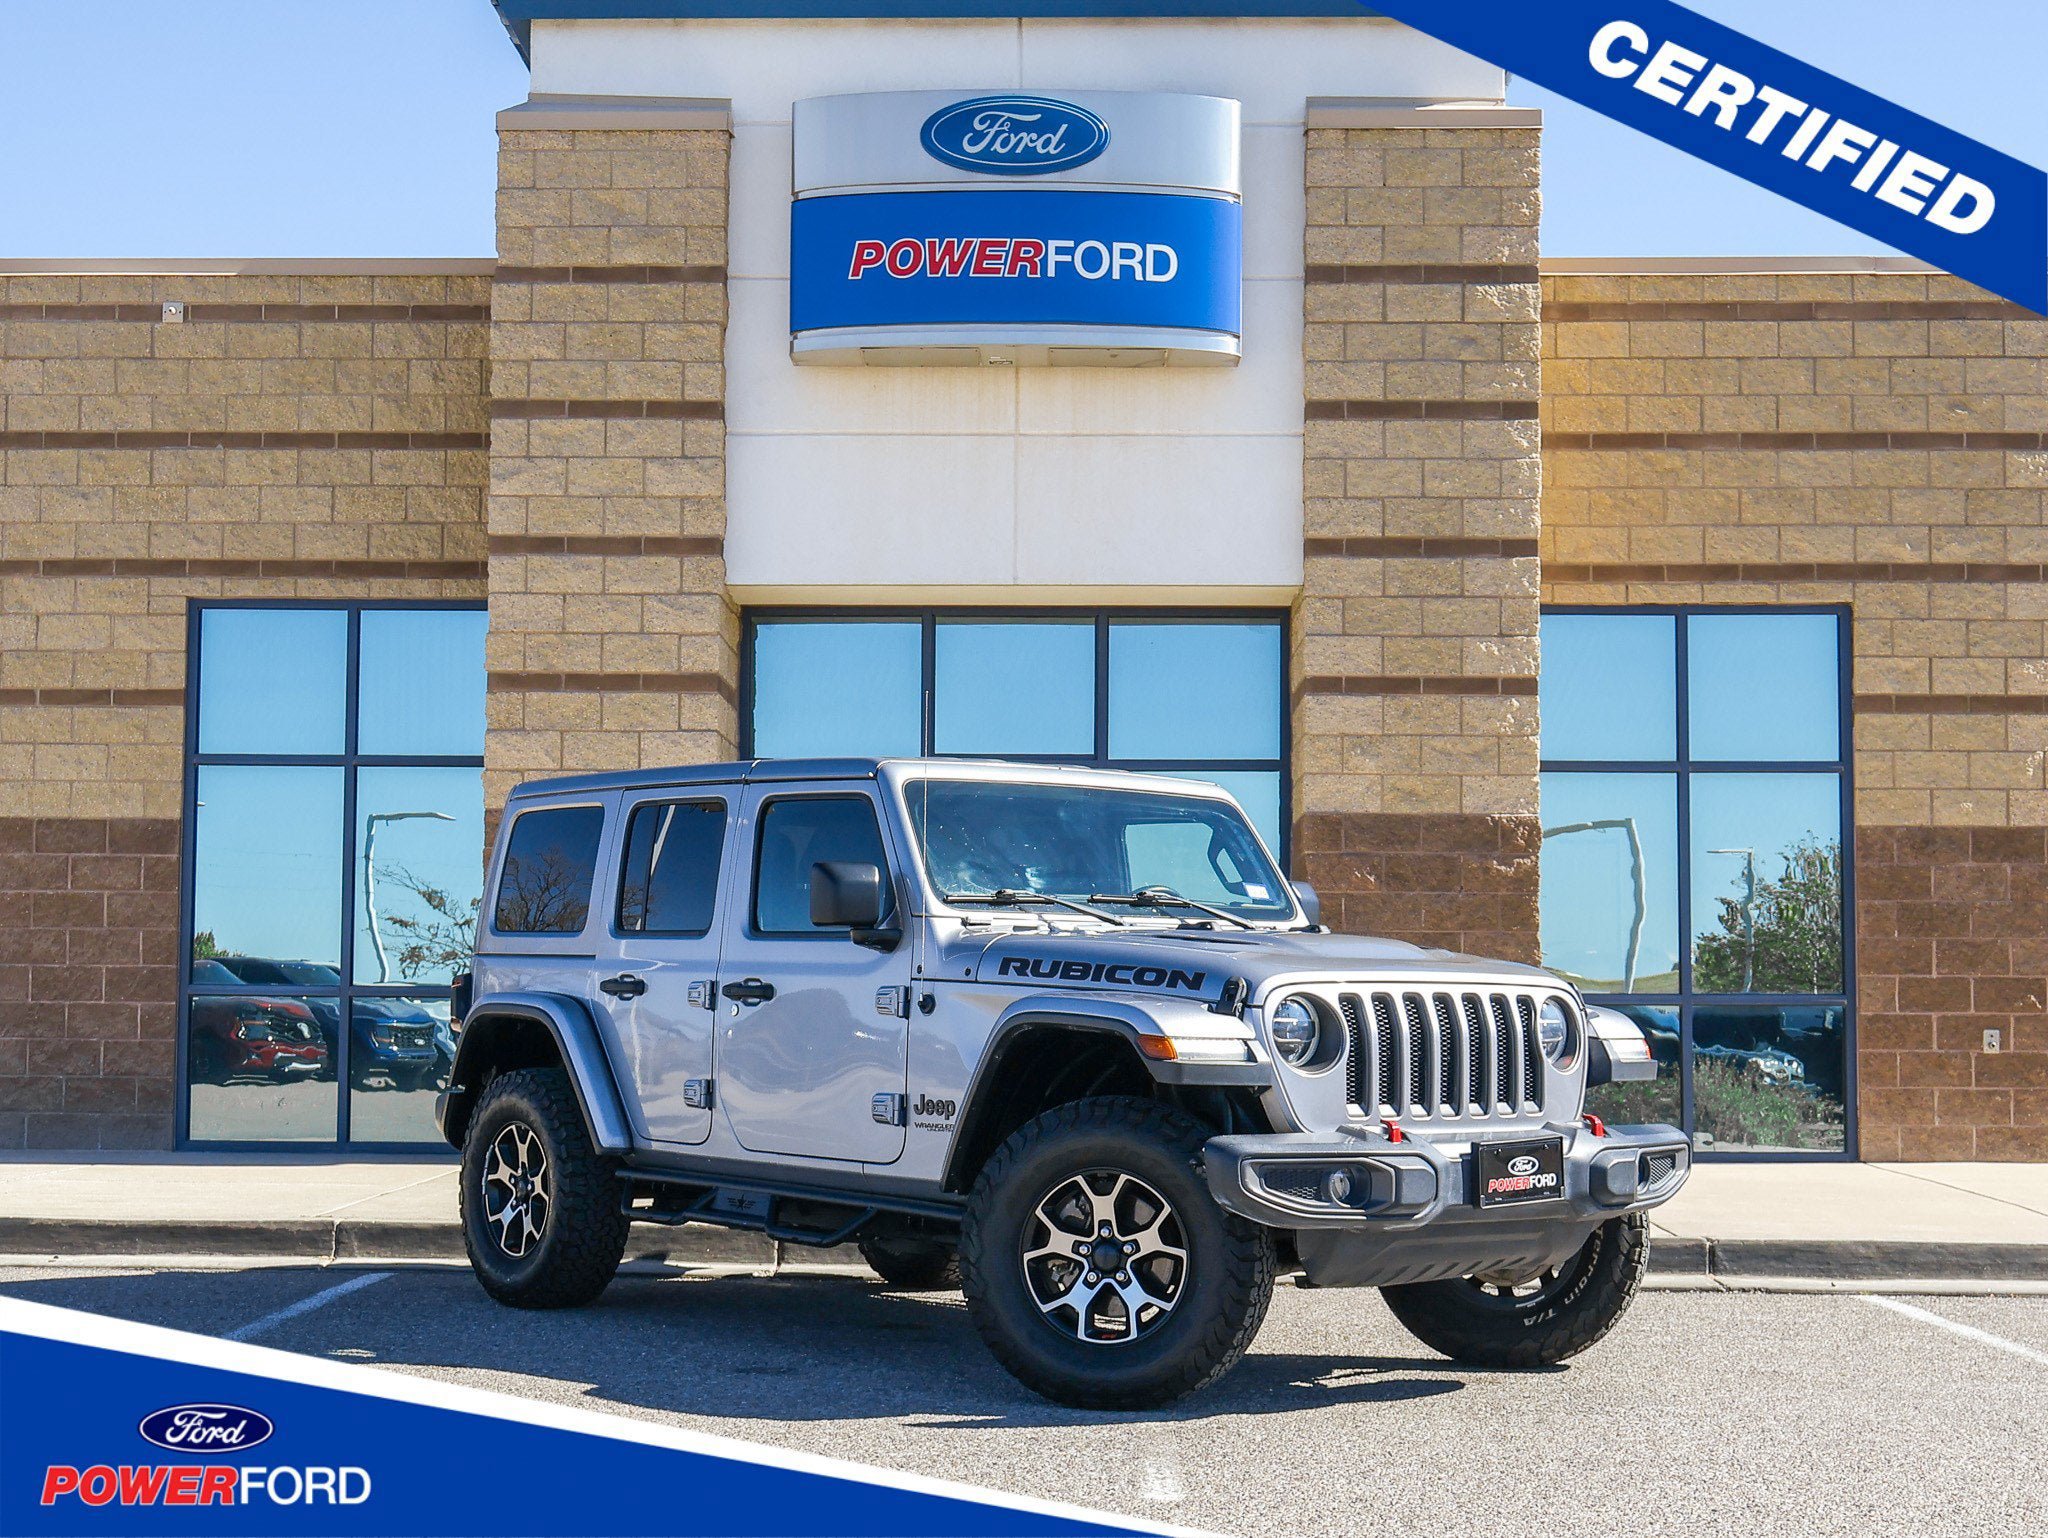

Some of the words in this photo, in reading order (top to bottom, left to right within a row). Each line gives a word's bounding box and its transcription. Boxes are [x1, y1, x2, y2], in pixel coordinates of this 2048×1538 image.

[963, 110, 1067, 157] Ford
[999, 957, 1206, 991] RUBICON
[913, 1093, 956, 1120] Jeep
[914, 1121, 954, 1129] WRANGLER
[1514, 1159, 1534, 1171] Ford
[1523, 1308, 1557, 1326] T/A
